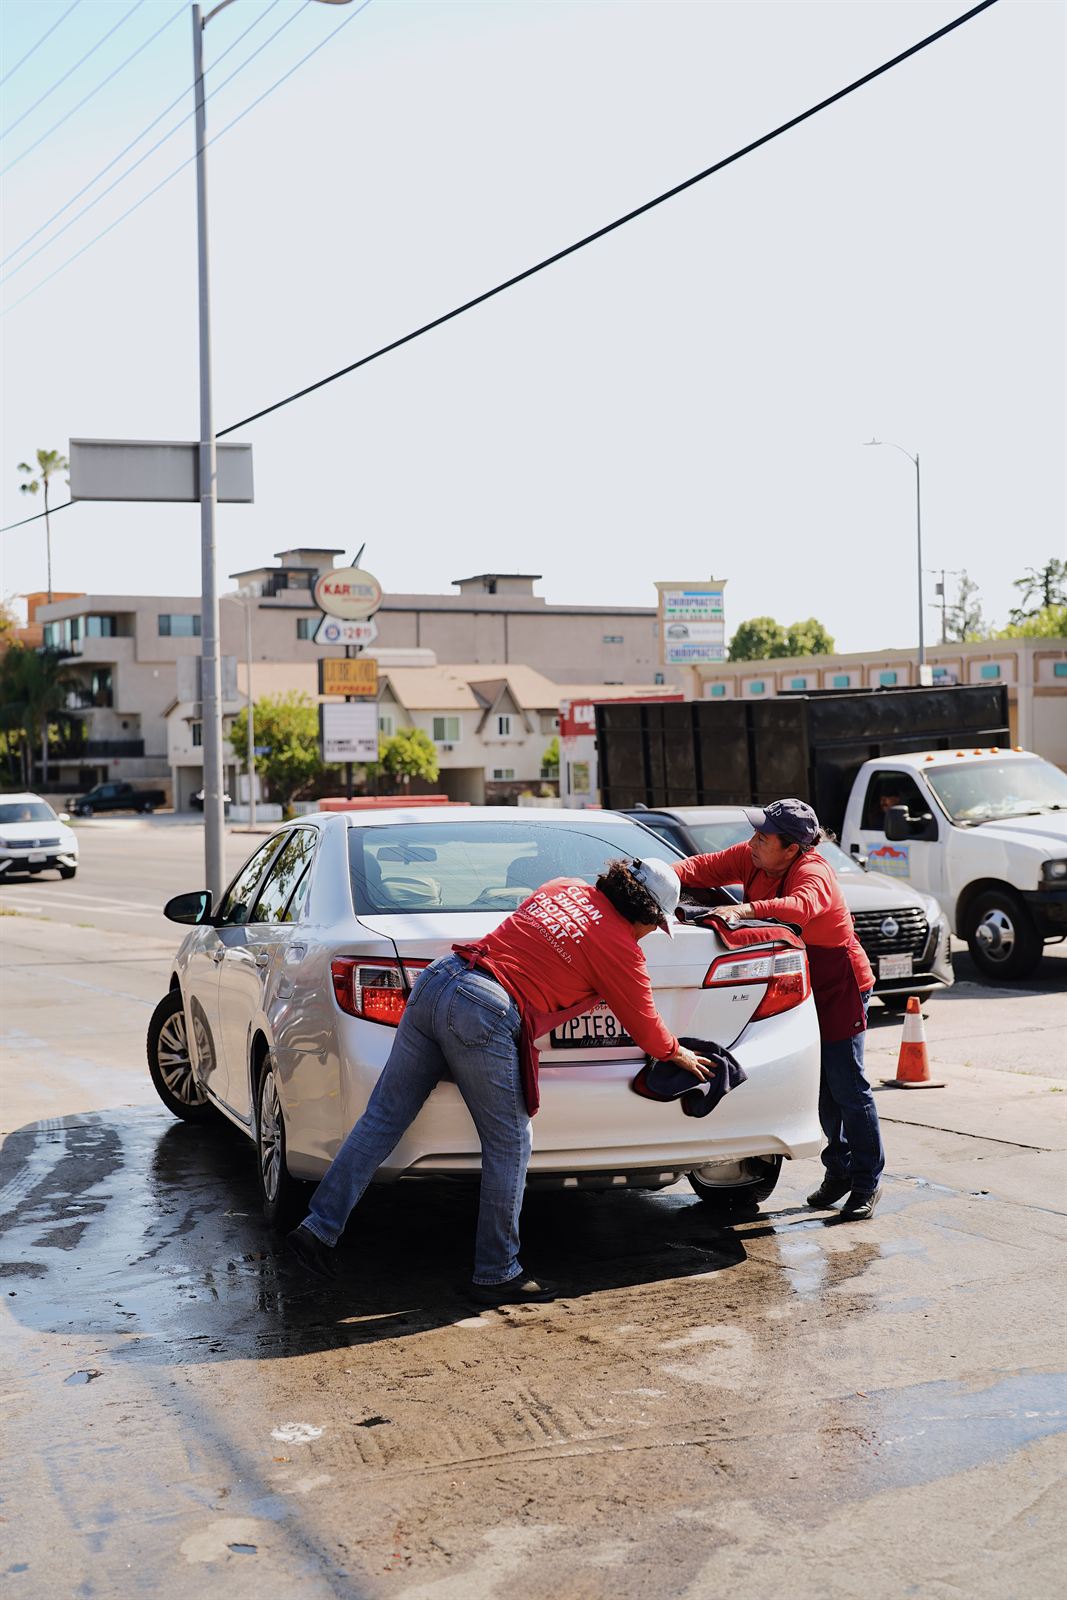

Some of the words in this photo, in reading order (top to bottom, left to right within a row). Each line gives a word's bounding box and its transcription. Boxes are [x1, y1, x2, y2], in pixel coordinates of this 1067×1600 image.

[668, 598, 721, 607] CHIROPRACTIC
[670, 648, 722, 657] CHIROPRACTIC
[526, 902, 568, 945] REPEAT.
[534, 892, 584, 944] PROTECT.
[553, 892, 589, 931] SHINE.
[567, 886, 603, 925] CLEAN.
